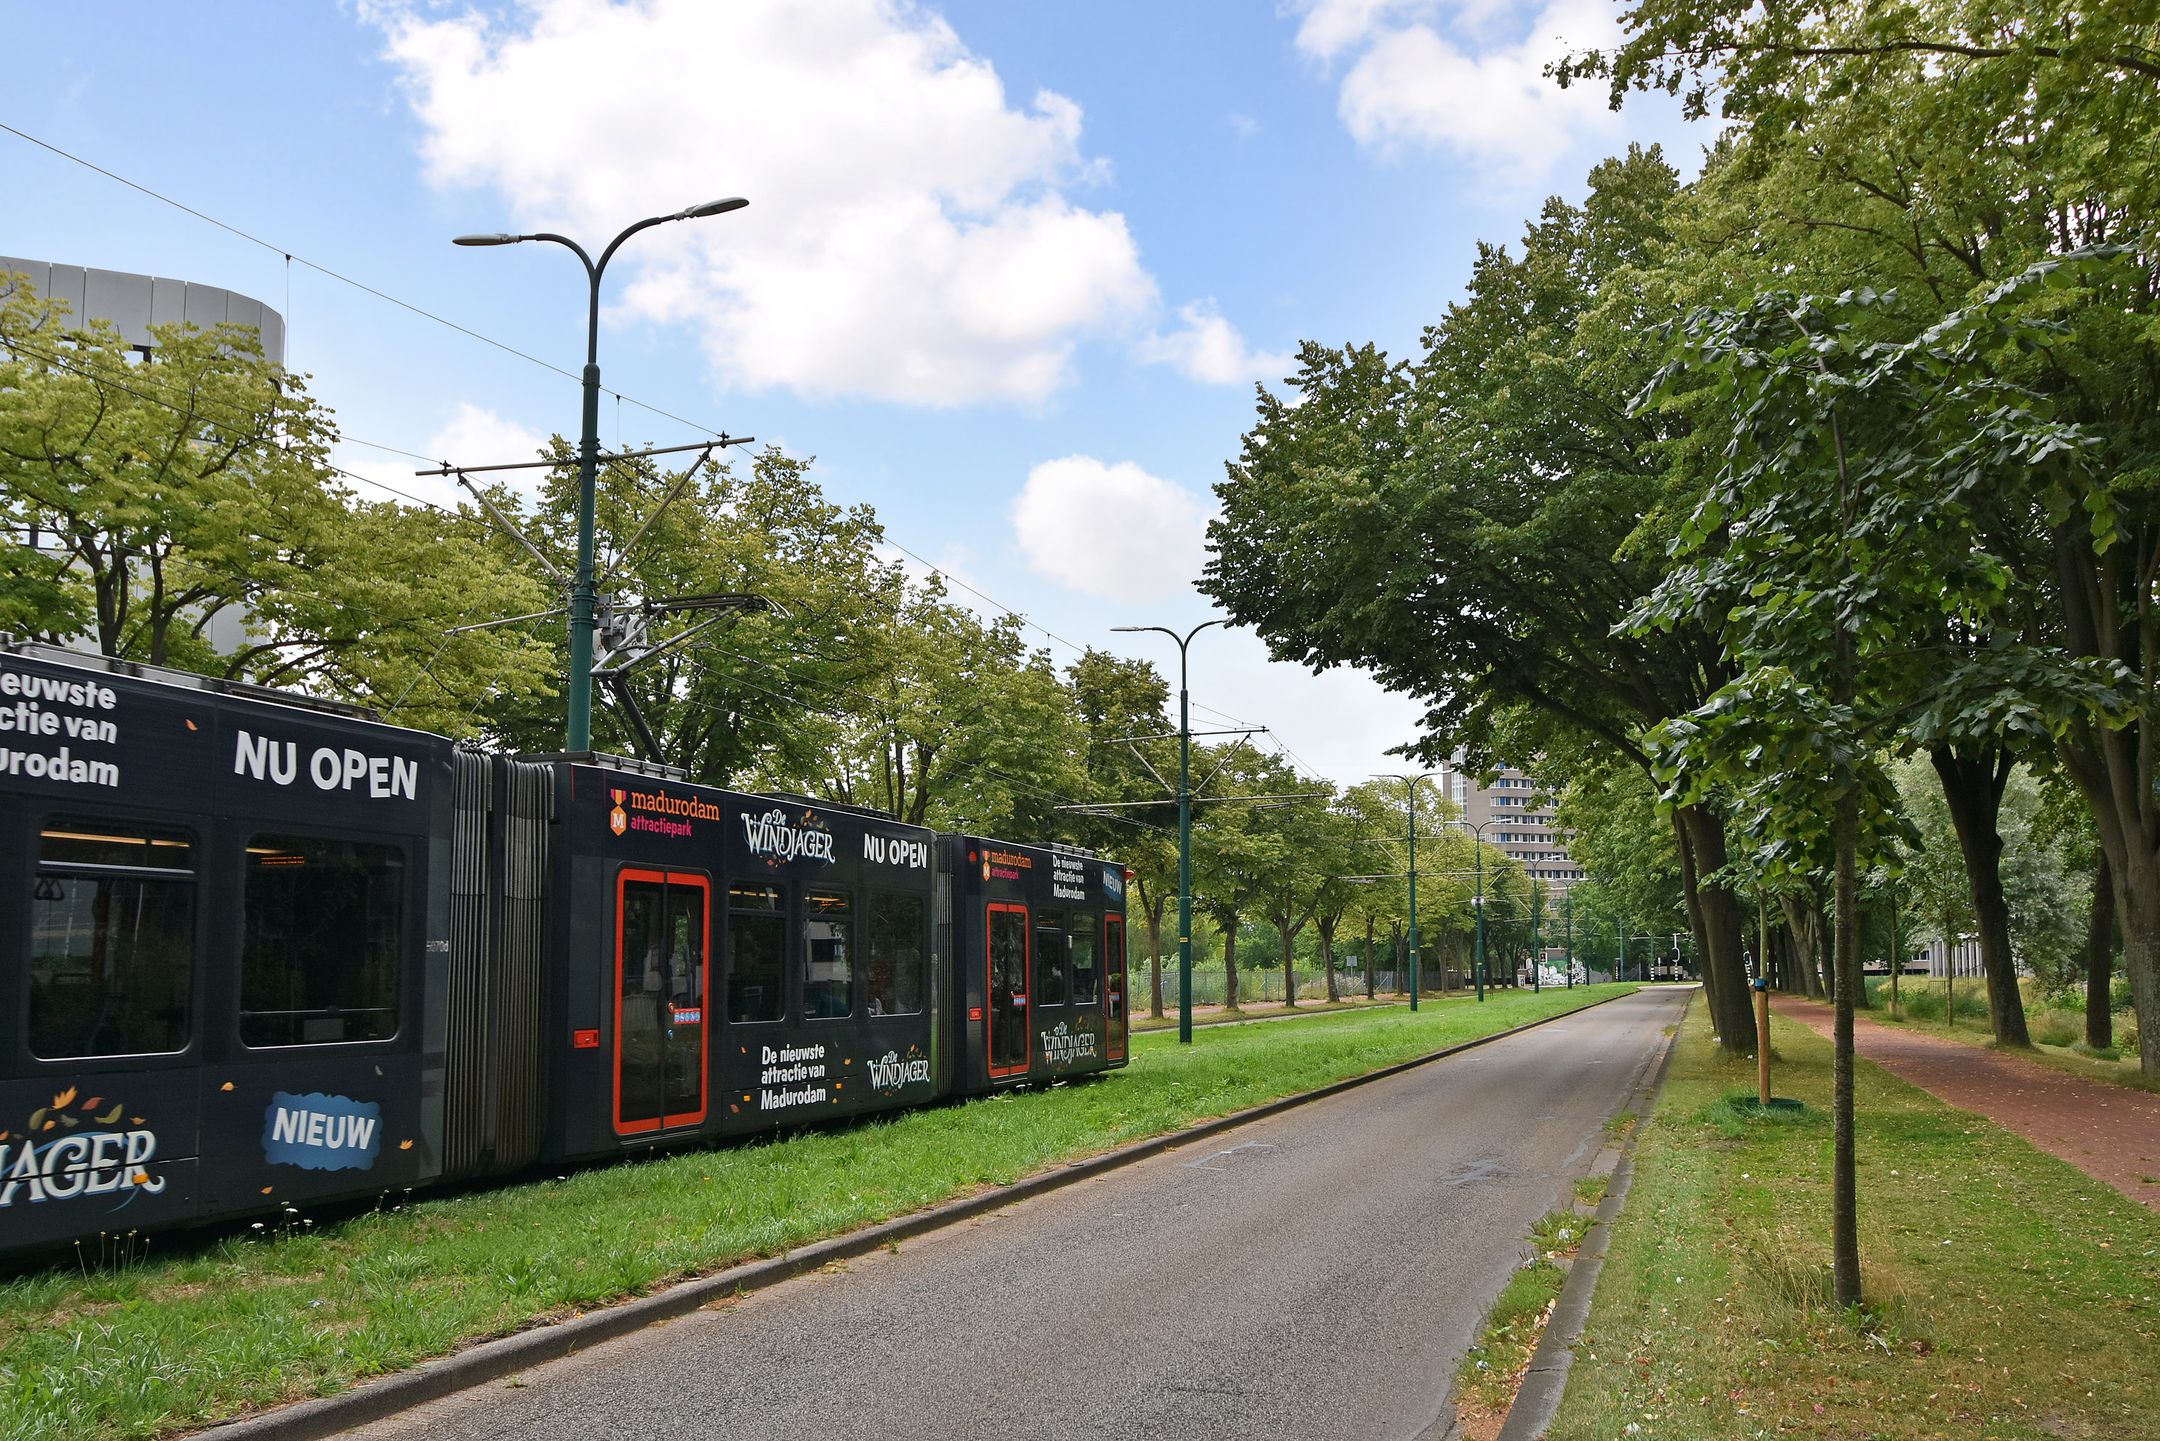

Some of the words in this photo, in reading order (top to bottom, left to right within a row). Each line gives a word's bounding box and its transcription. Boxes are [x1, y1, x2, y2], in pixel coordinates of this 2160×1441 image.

[0, 672, 117, 710] euwste
[63, 715, 118, 744] van
[234, 730, 297, 786] NU
[310, 747, 418, 801] OPEN
[631, 789, 720, 821] madurodam
[771, 808, 787, 825] De
[613, 813, 625, 828] M
[631, 815, 693, 838] attractiepark
[741, 812, 835, 864] WINDJAGER
[863, 832, 885, 864] NU
[889, 839, 927, 869] OPEN
[991, 850, 1032, 869] madurodam
[1052, 854, 1060, 868] De
[1061, 856, 1083, 871] nieuwste
[1053, 869, 1075, 883] attractie
[1076, 874, 1085, 884] van
[1103, 870, 1122, 895] NIEUW
[1053, 883, 1085, 900] Madurodam
[762, 1045, 777, 1065] De
[780, 1043, 825, 1063] nieuwste
[887, 1050, 898, 1064] De
[761, 1063, 807, 1085] attractie
[808, 1064, 825, 1078] van
[866, 1055, 931, 1090] WINDJAGER
[760, 1084, 826, 1110] Madurodam
[272, 1107, 376, 1150] NIEUW
